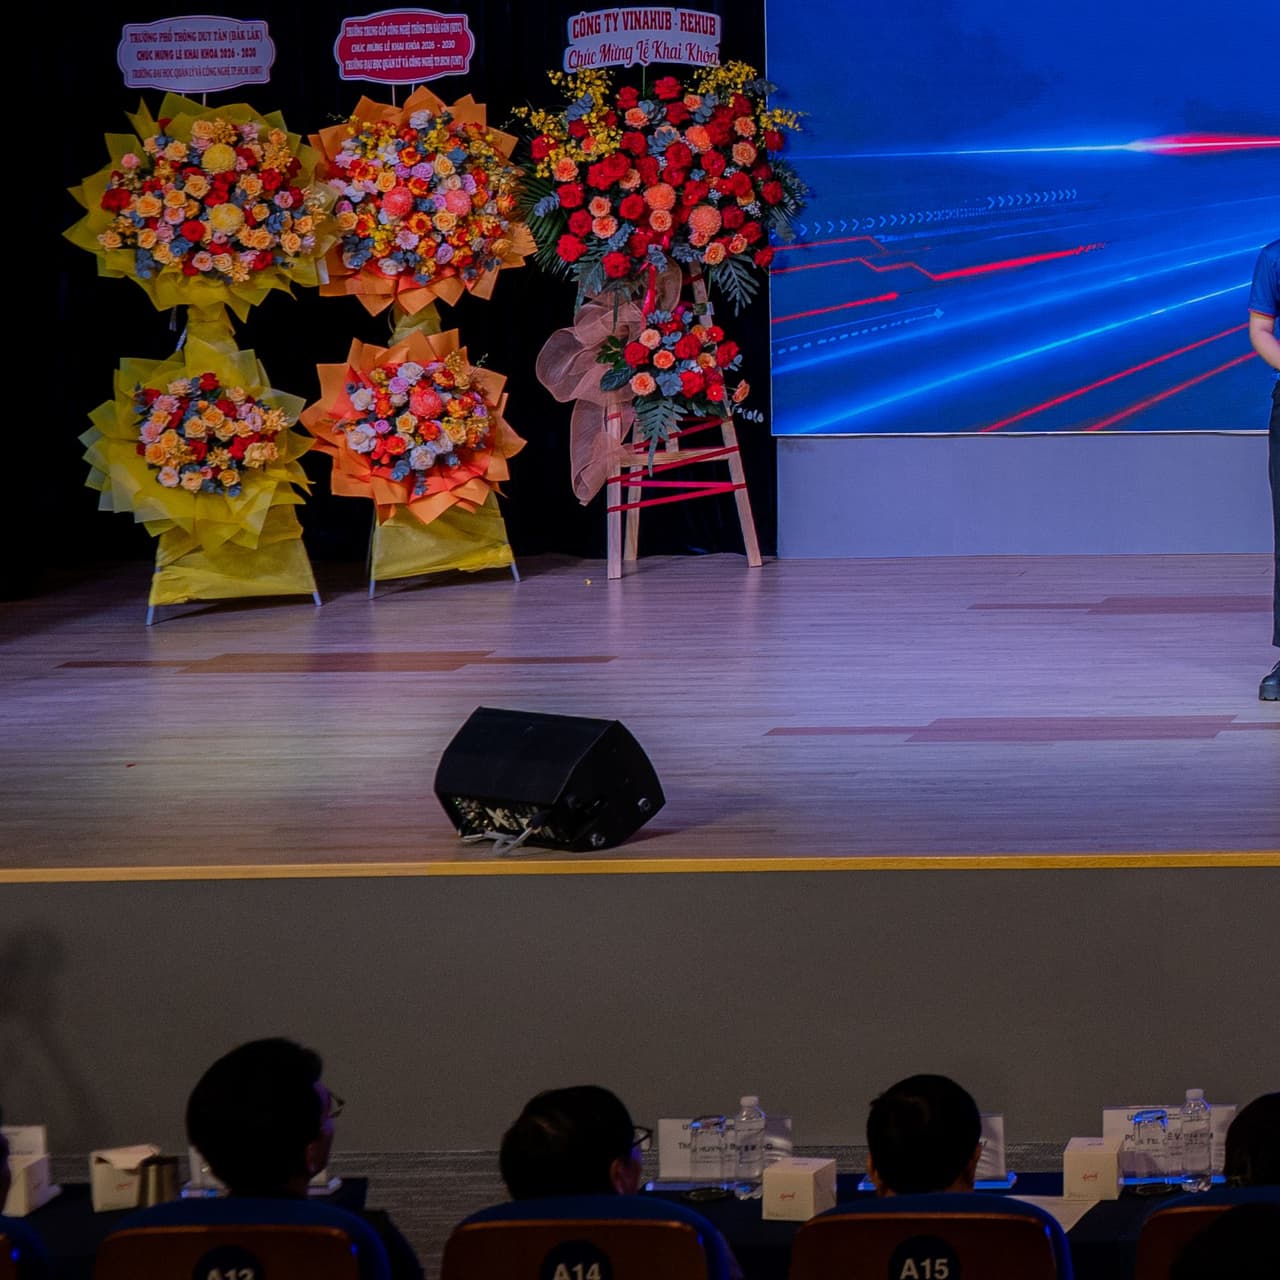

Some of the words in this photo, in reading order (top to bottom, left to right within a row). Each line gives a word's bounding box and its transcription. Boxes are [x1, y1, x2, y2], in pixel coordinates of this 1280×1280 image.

[604, 14, 619, 32] TY
[622, 11, 671, 31] VINAHUB
[680, 12, 716, 36] REHUB
[568, 46, 596, 69] Chúc
[599, 43, 633, 65] Mừng
[636, 38, 650, 65] Lễ
[652, 39, 682, 61] Khai
[685, 42, 718, 66] Khóa
[553, 1263, 602, 1280] A14
[900, 1257, 949, 1280] A15
